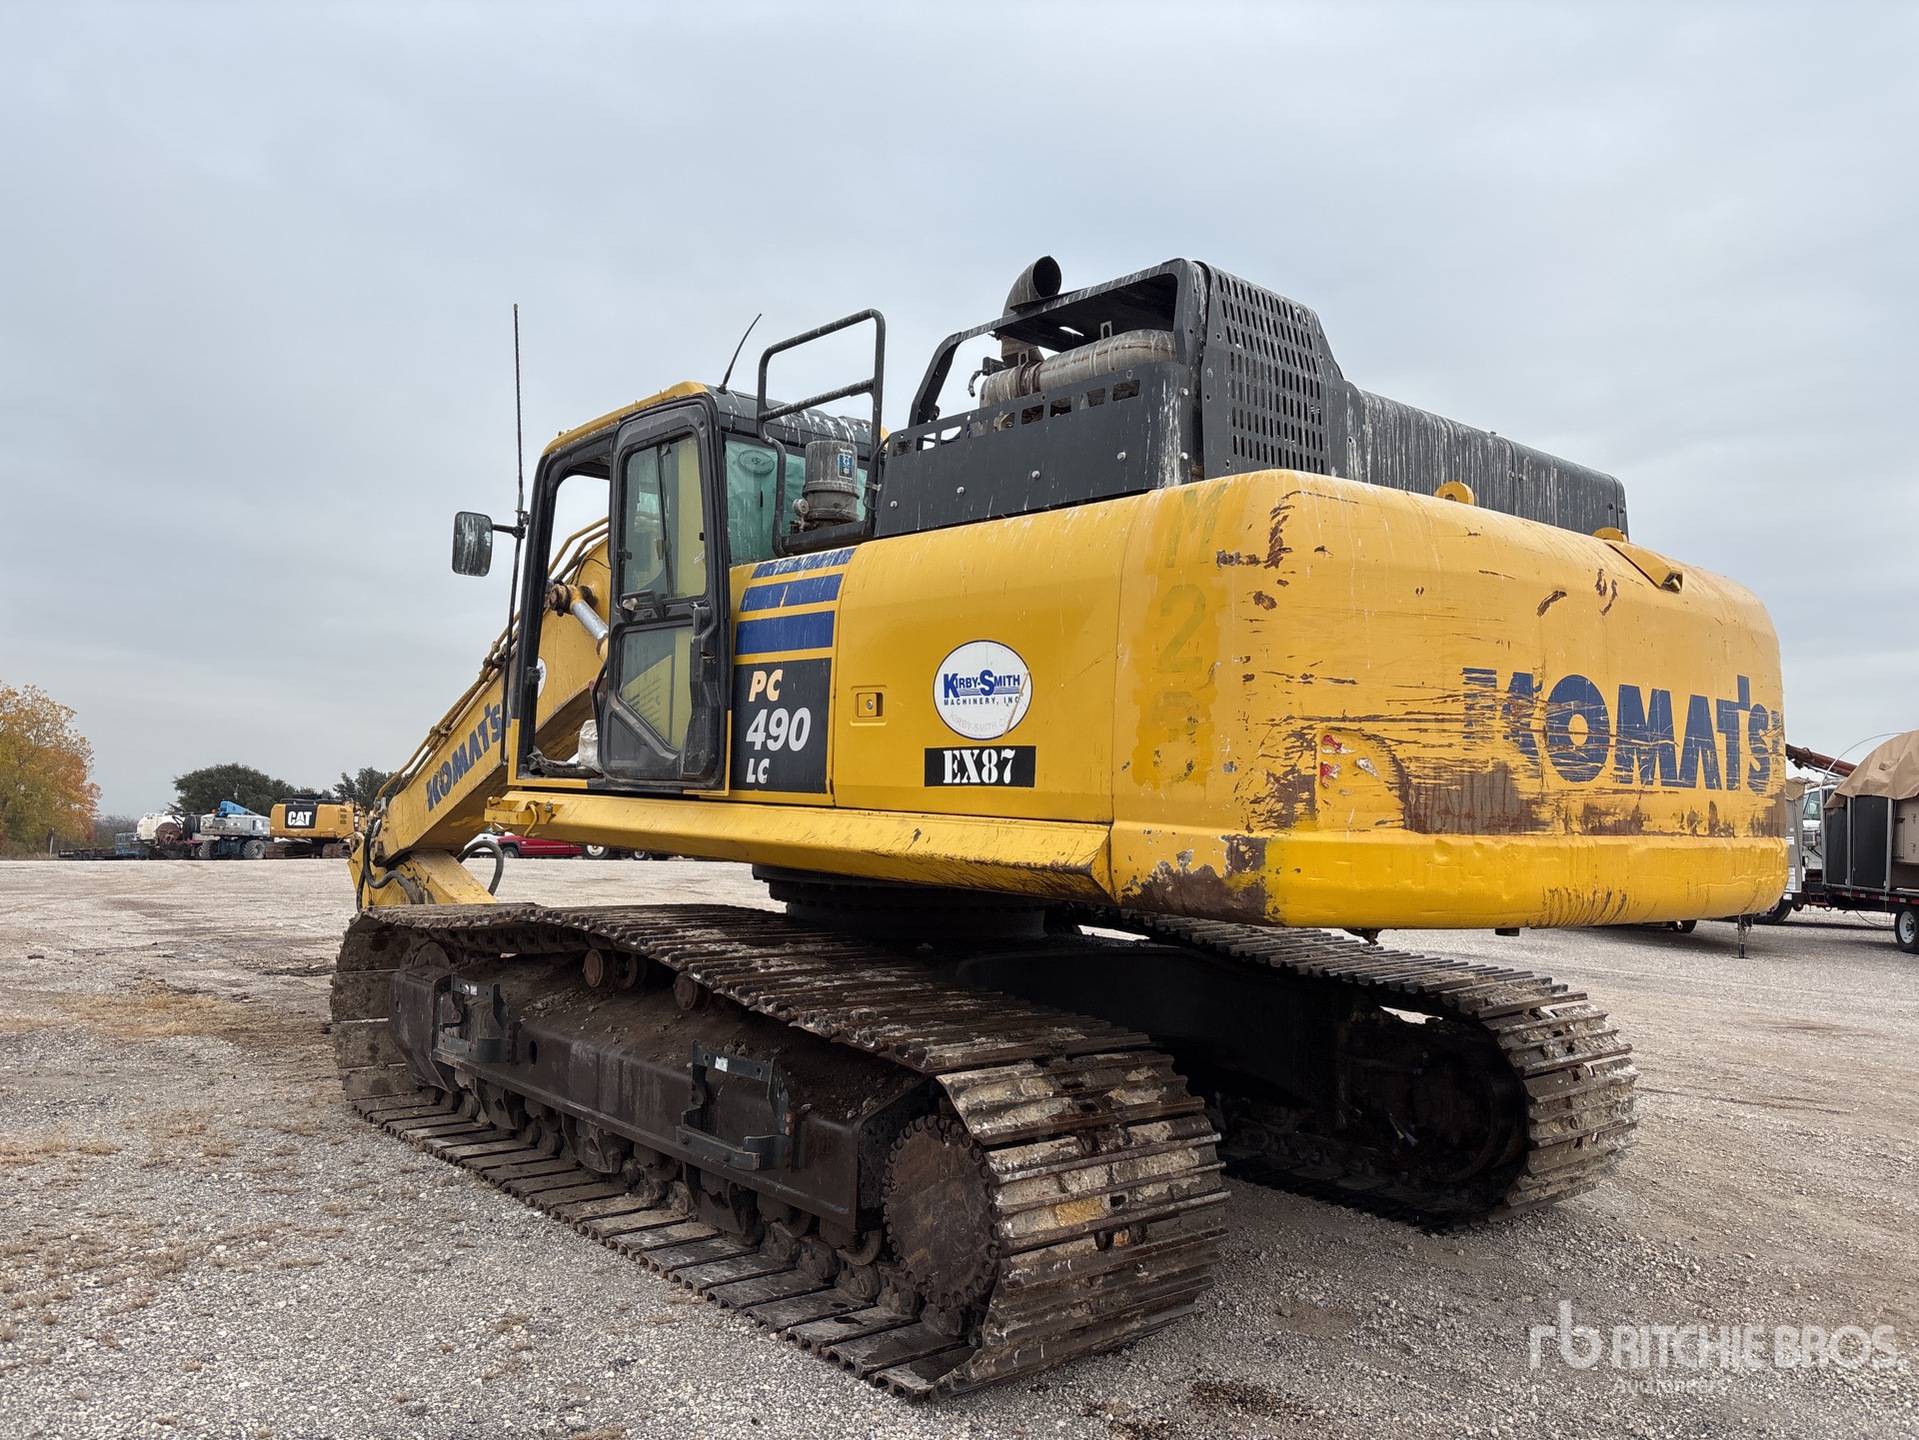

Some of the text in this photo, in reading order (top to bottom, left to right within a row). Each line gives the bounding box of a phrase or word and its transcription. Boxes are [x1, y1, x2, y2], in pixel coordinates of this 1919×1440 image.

[748, 669, 783, 702] PC
[943, 669, 1021, 699] KIRBY-SMITH
[745, 707, 812, 751] 490
[745, 758, 770, 784] LC
[942, 748, 1016, 785] EX87
[287, 811, 313, 827] CAT
